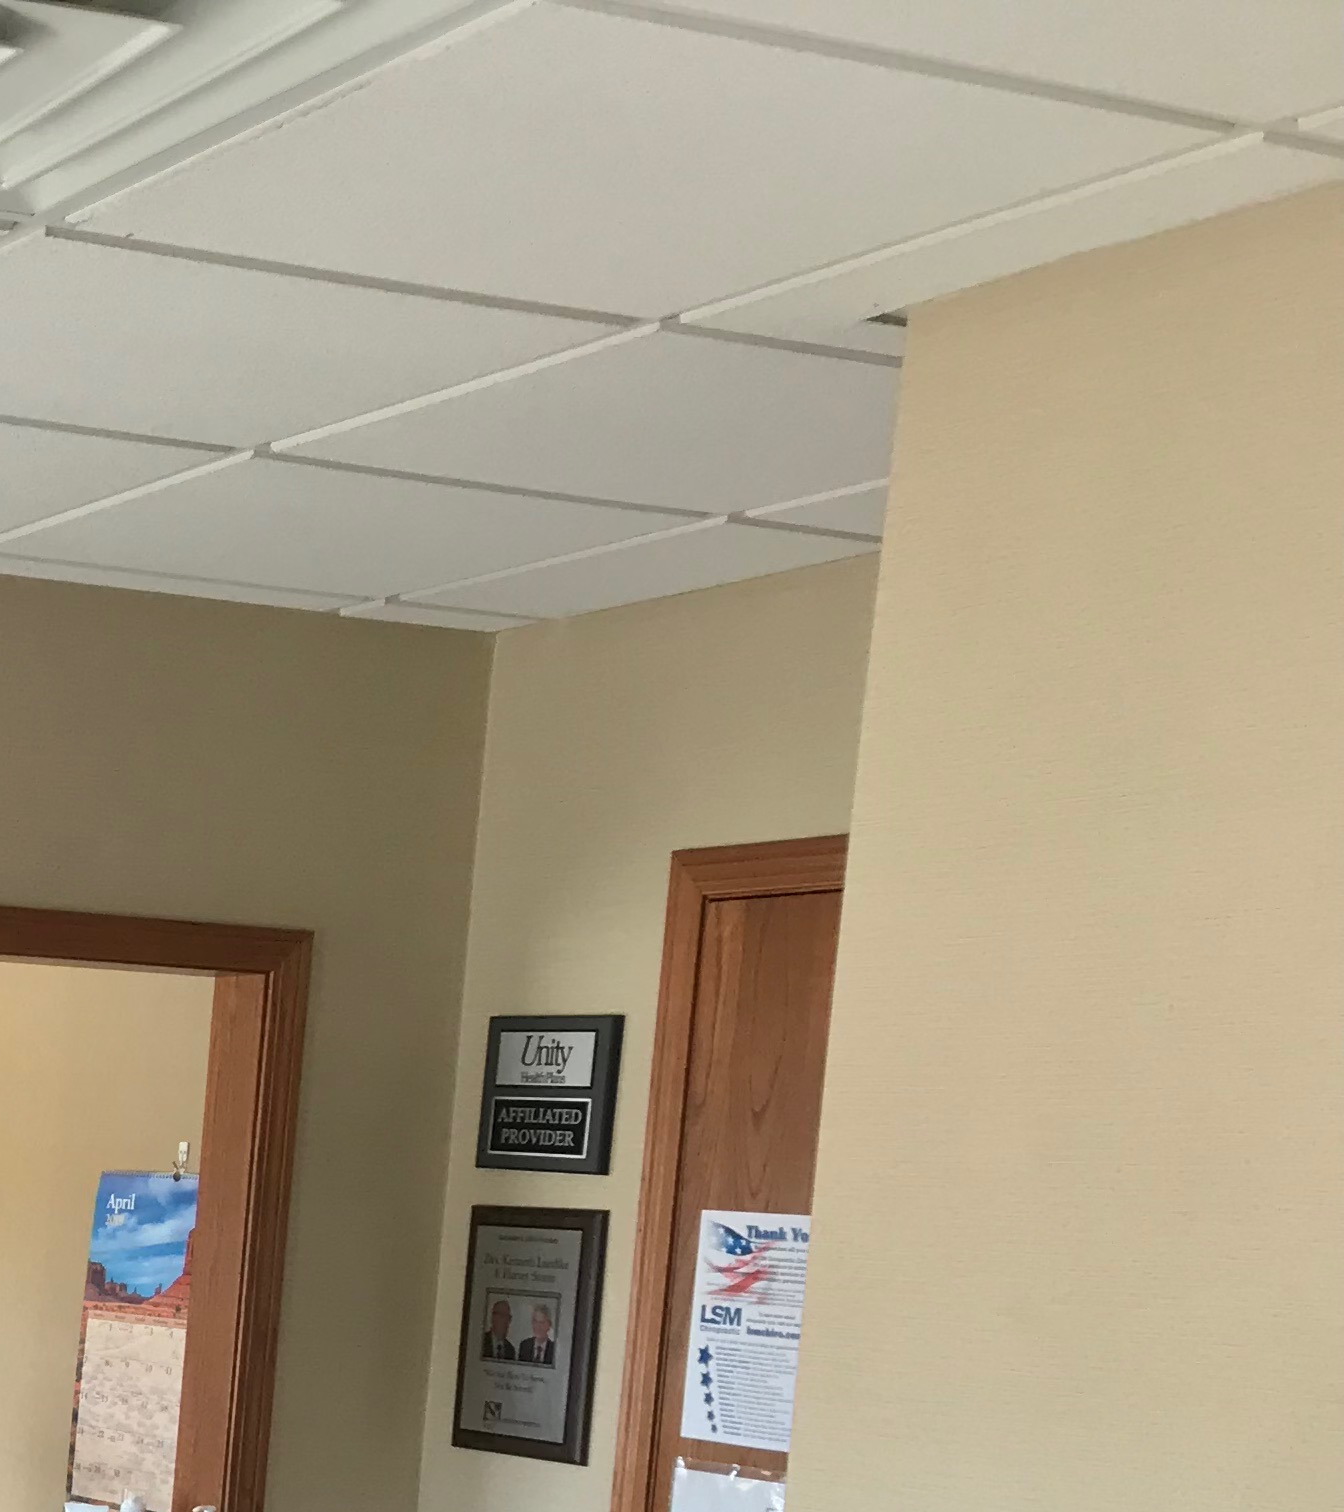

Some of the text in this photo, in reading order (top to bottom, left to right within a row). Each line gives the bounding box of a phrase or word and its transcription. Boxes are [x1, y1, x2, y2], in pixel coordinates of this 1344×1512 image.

[521, 1034, 574, 1074] Unity
[497, 1106, 583, 1125] AFFILIATED
[500, 1128, 575, 1147] PROVIDER
[106, 1193, 136, 1214] April
[746, 1225, 788, 1241] Thank
[700, 1304, 742, 1327] LSM
